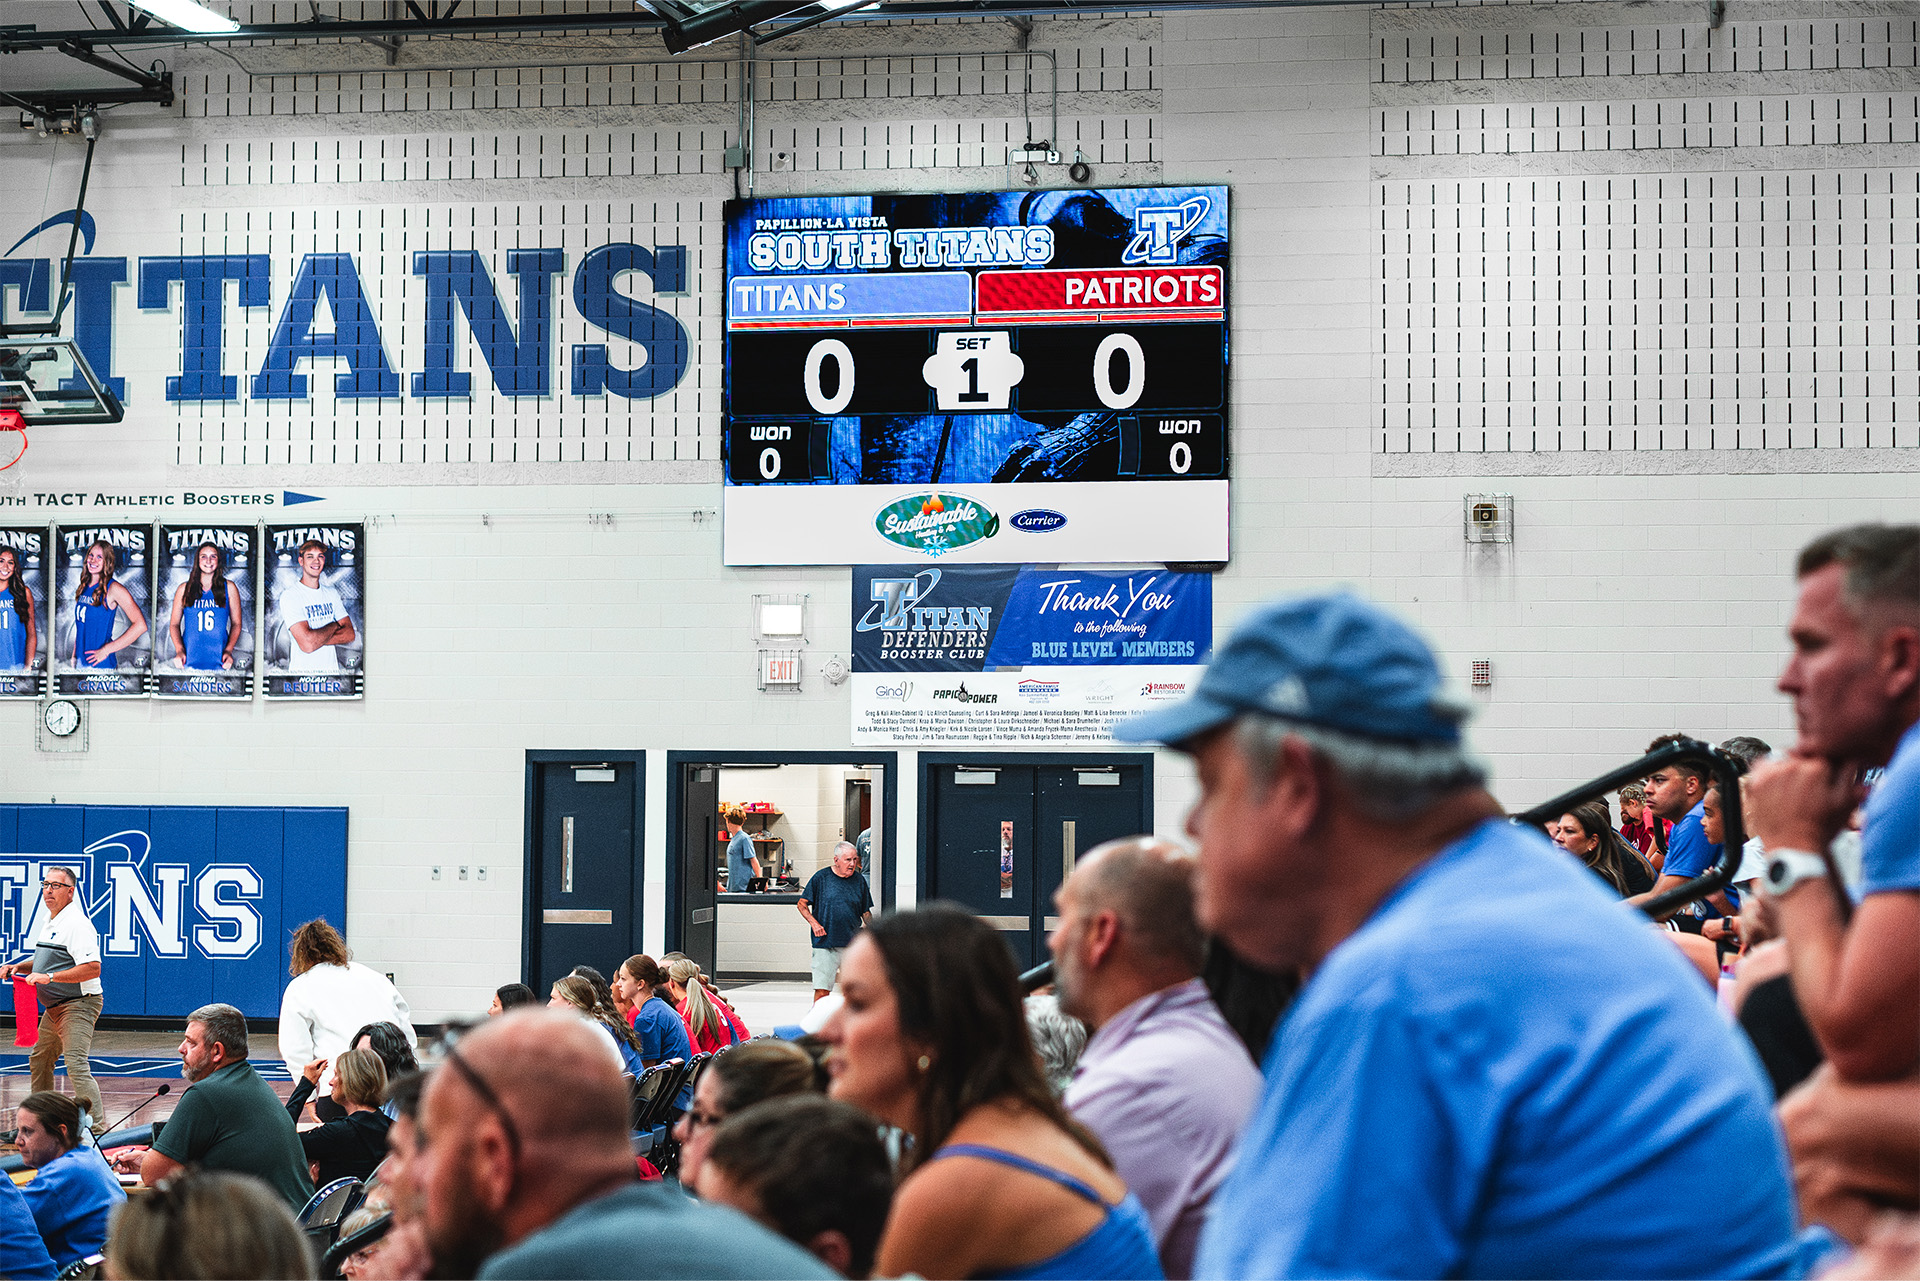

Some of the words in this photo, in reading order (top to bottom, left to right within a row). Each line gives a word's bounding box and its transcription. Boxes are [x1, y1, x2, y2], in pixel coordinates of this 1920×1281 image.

[756, 217, 844, 231] PAPILLION-LA
[850, 216, 888, 229] VISTA
[749, 229, 891, 271] SOUTH
[894, 225, 1055, 268] TITANS
[735, 283, 846, 312] TITANS
[1065, 273, 1217, 305] PATRIOTS
[956, 338, 991, 350] SET
[804, 339, 855, 415] 0
[958, 358, 989, 403] 1
[1093, 333, 1145, 410] 0
[759, 447, 781, 480] 0
[1169, 441, 1192, 474] 0
[33, 493, 88, 506] TACT
[884, 501, 979, 535] Sustainable
[1017, 515, 1061, 527] Carrier
[64, 528, 145, 551] TITANS
[168, 528, 249, 551] TITANS
[273, 528, 354, 551] TITANS
[871, 578, 992, 631] TITAN
[1038, 579, 1120, 618] Thank
[1121, 576, 1175, 618] You
[76, 604, 87, 623] 14
[304, 602, 334, 619] TITANS
[197, 610, 214, 631] 16
[1074, 621, 1084, 633] to
[1085, 620, 1100, 633] the
[1100, 619, 1147, 638] following
[881, 631, 988, 648] DEFENDERS
[880, 650, 944, 660] BOOSTER
[949, 649, 985, 659] CLUB
[1032, 642, 1068, 658] BLUE
[1072, 641, 1117, 657] LEVEL
[1122, 641, 1195, 657] MEMBERS
[769, 661, 794, 680] EXIT
[78, 680, 126, 692] GRAVES
[173, 681, 232, 693] SANDERS
[284, 681, 342, 693] BEUTLER
[875, 685, 903, 697] Gina
[966, 694, 998, 703] POWER
